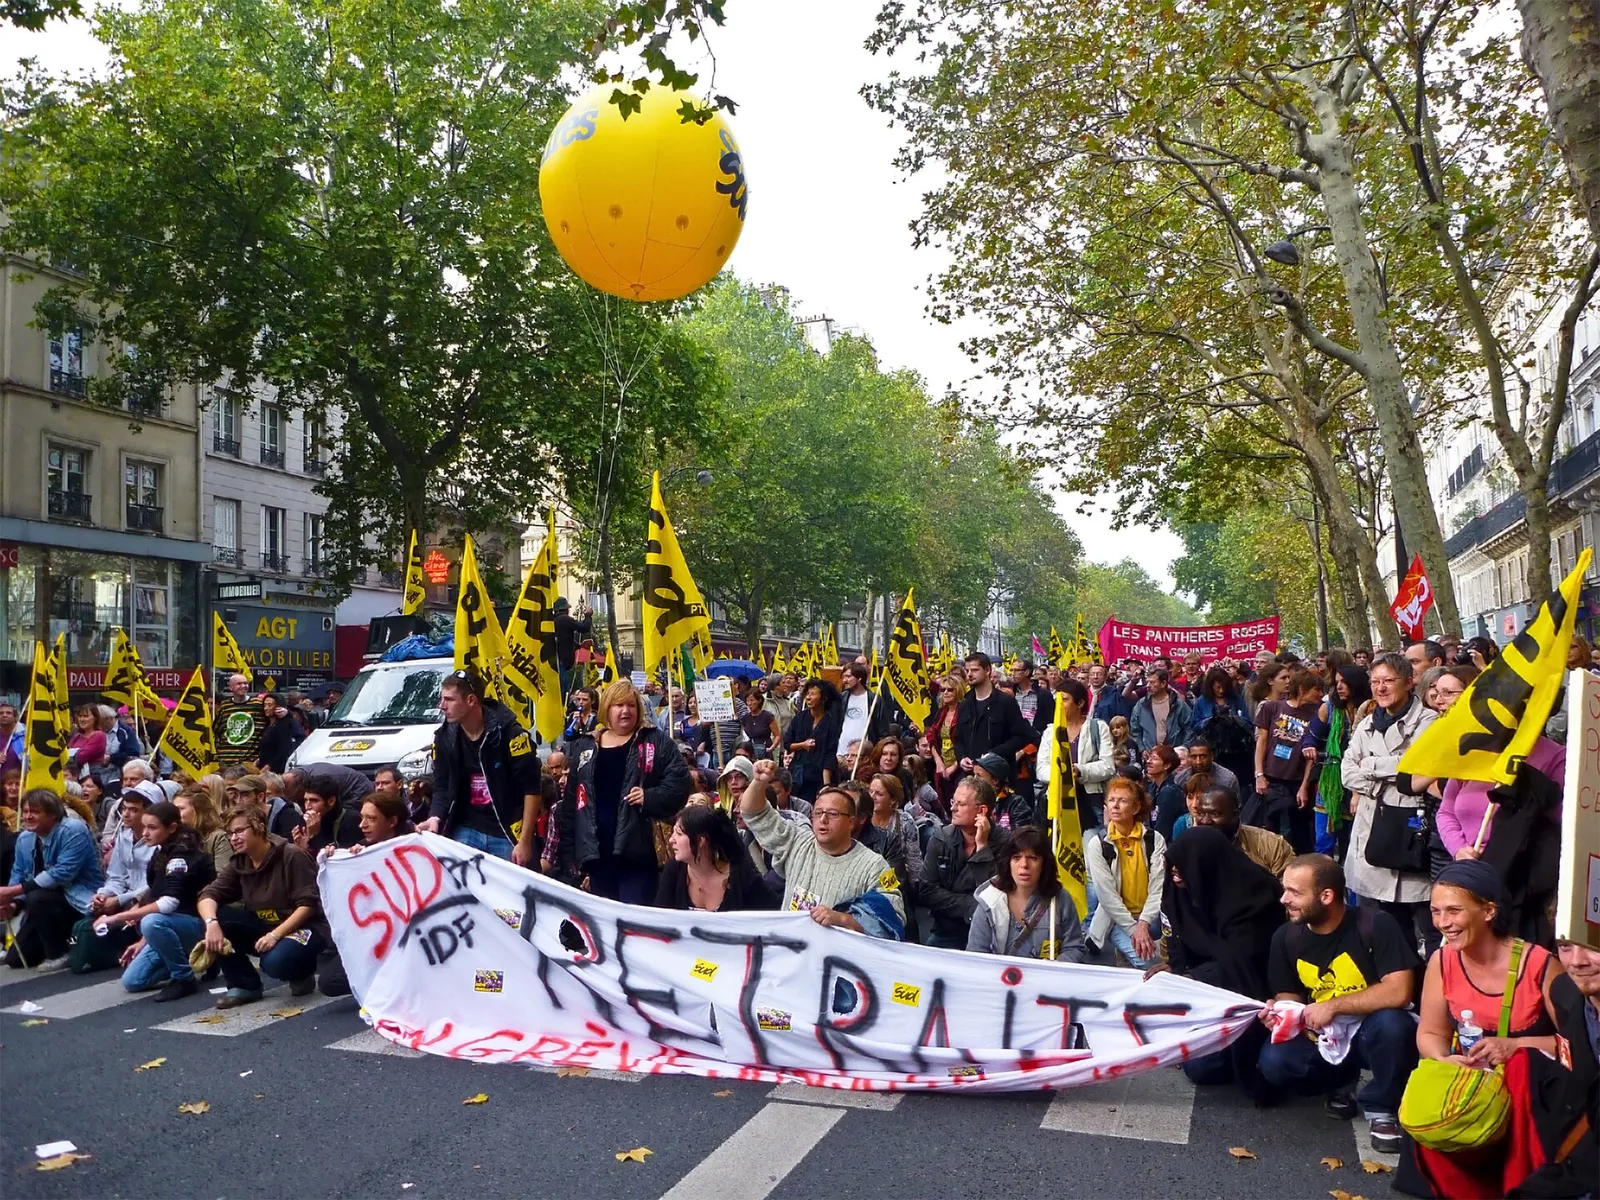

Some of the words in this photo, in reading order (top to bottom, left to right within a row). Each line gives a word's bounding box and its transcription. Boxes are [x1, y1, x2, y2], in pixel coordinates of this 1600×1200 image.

[256, 616, 298, 640] AGT
[1113, 626, 1140, 640] LES
[1145, 629, 1225, 643] PANTHERES
[1231, 623, 1274, 640] ROSES
[1123, 643, 1162, 657] TRANS
[1169, 646, 1218, 658] GOUINES
[1226, 639, 1265, 655] PÉDÉS
[70, 672, 104, 688] PAUL
[347, 844, 443, 961] SUD
